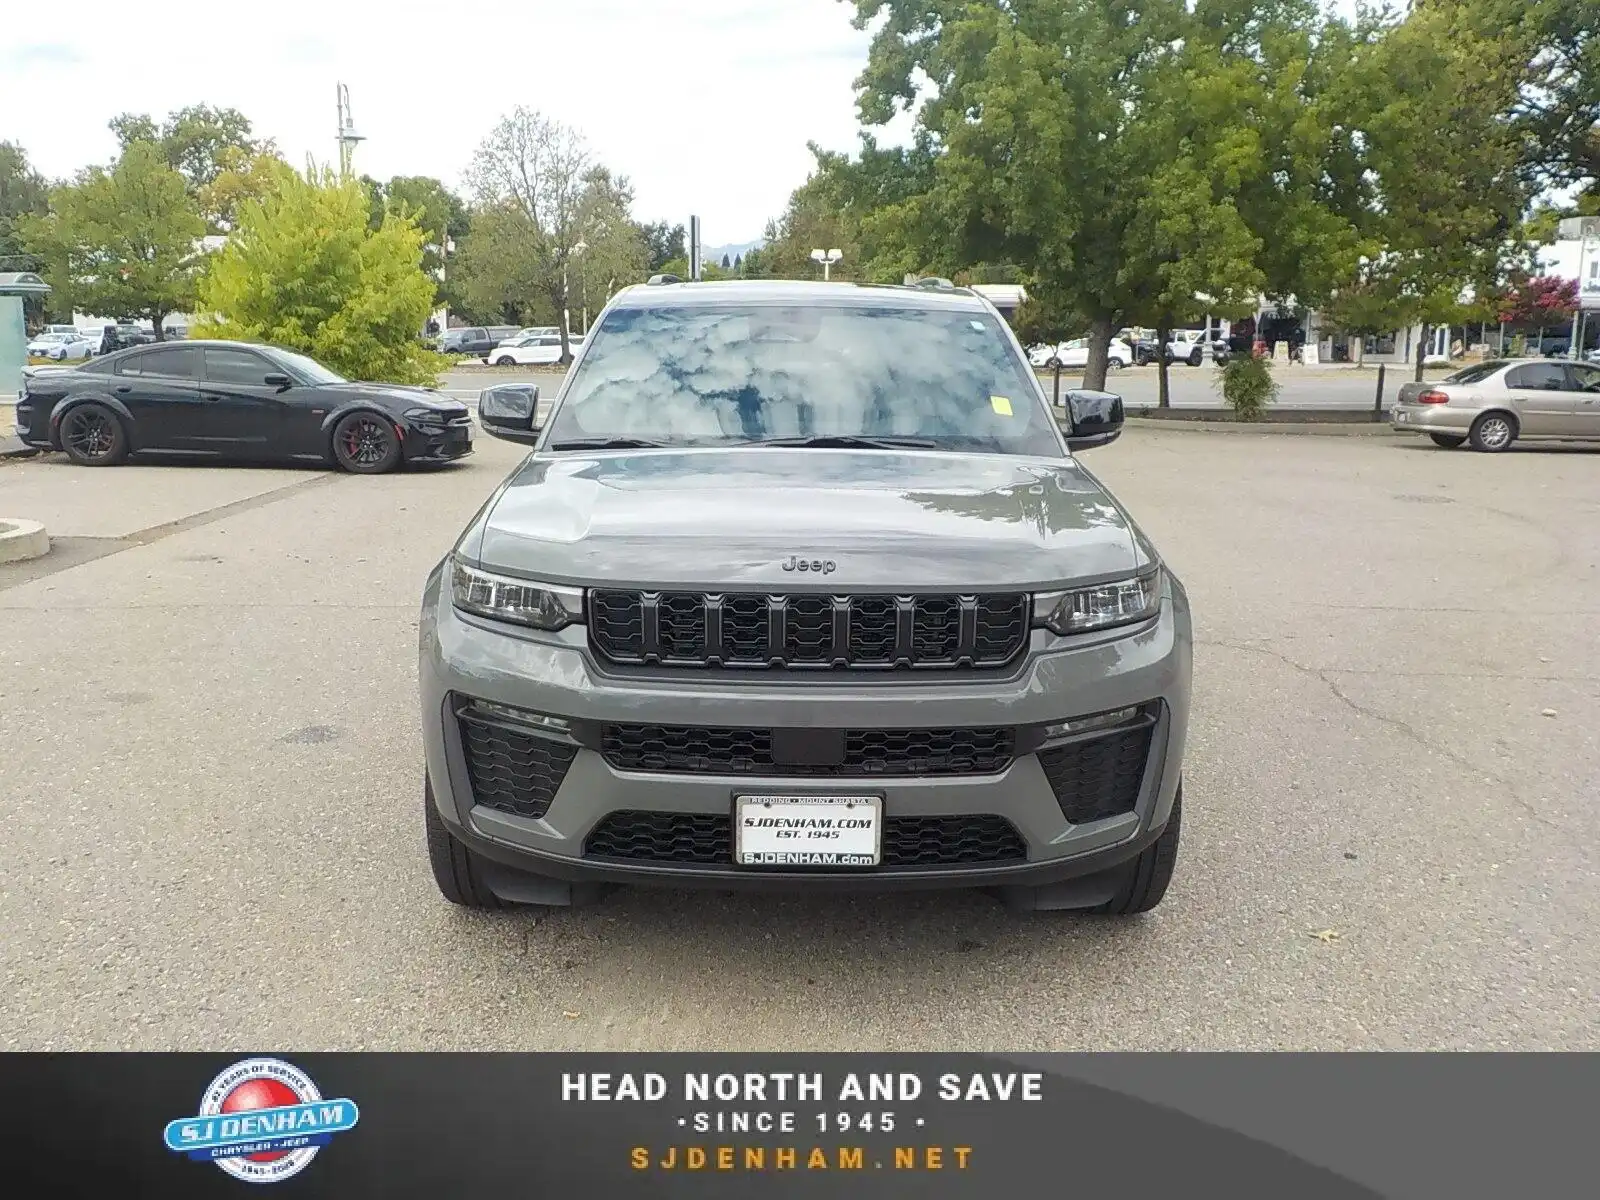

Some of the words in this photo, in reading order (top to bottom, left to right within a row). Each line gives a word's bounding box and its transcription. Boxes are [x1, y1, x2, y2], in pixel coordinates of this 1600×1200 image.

[781, 555, 836, 575] Jeep
[744, 817, 872, 829] SJDENHAM.COM
[776, 830, 801, 839] EST.
[807, 830, 840, 839] 1945
[743, 852, 873, 865] SJDENHAM.com
